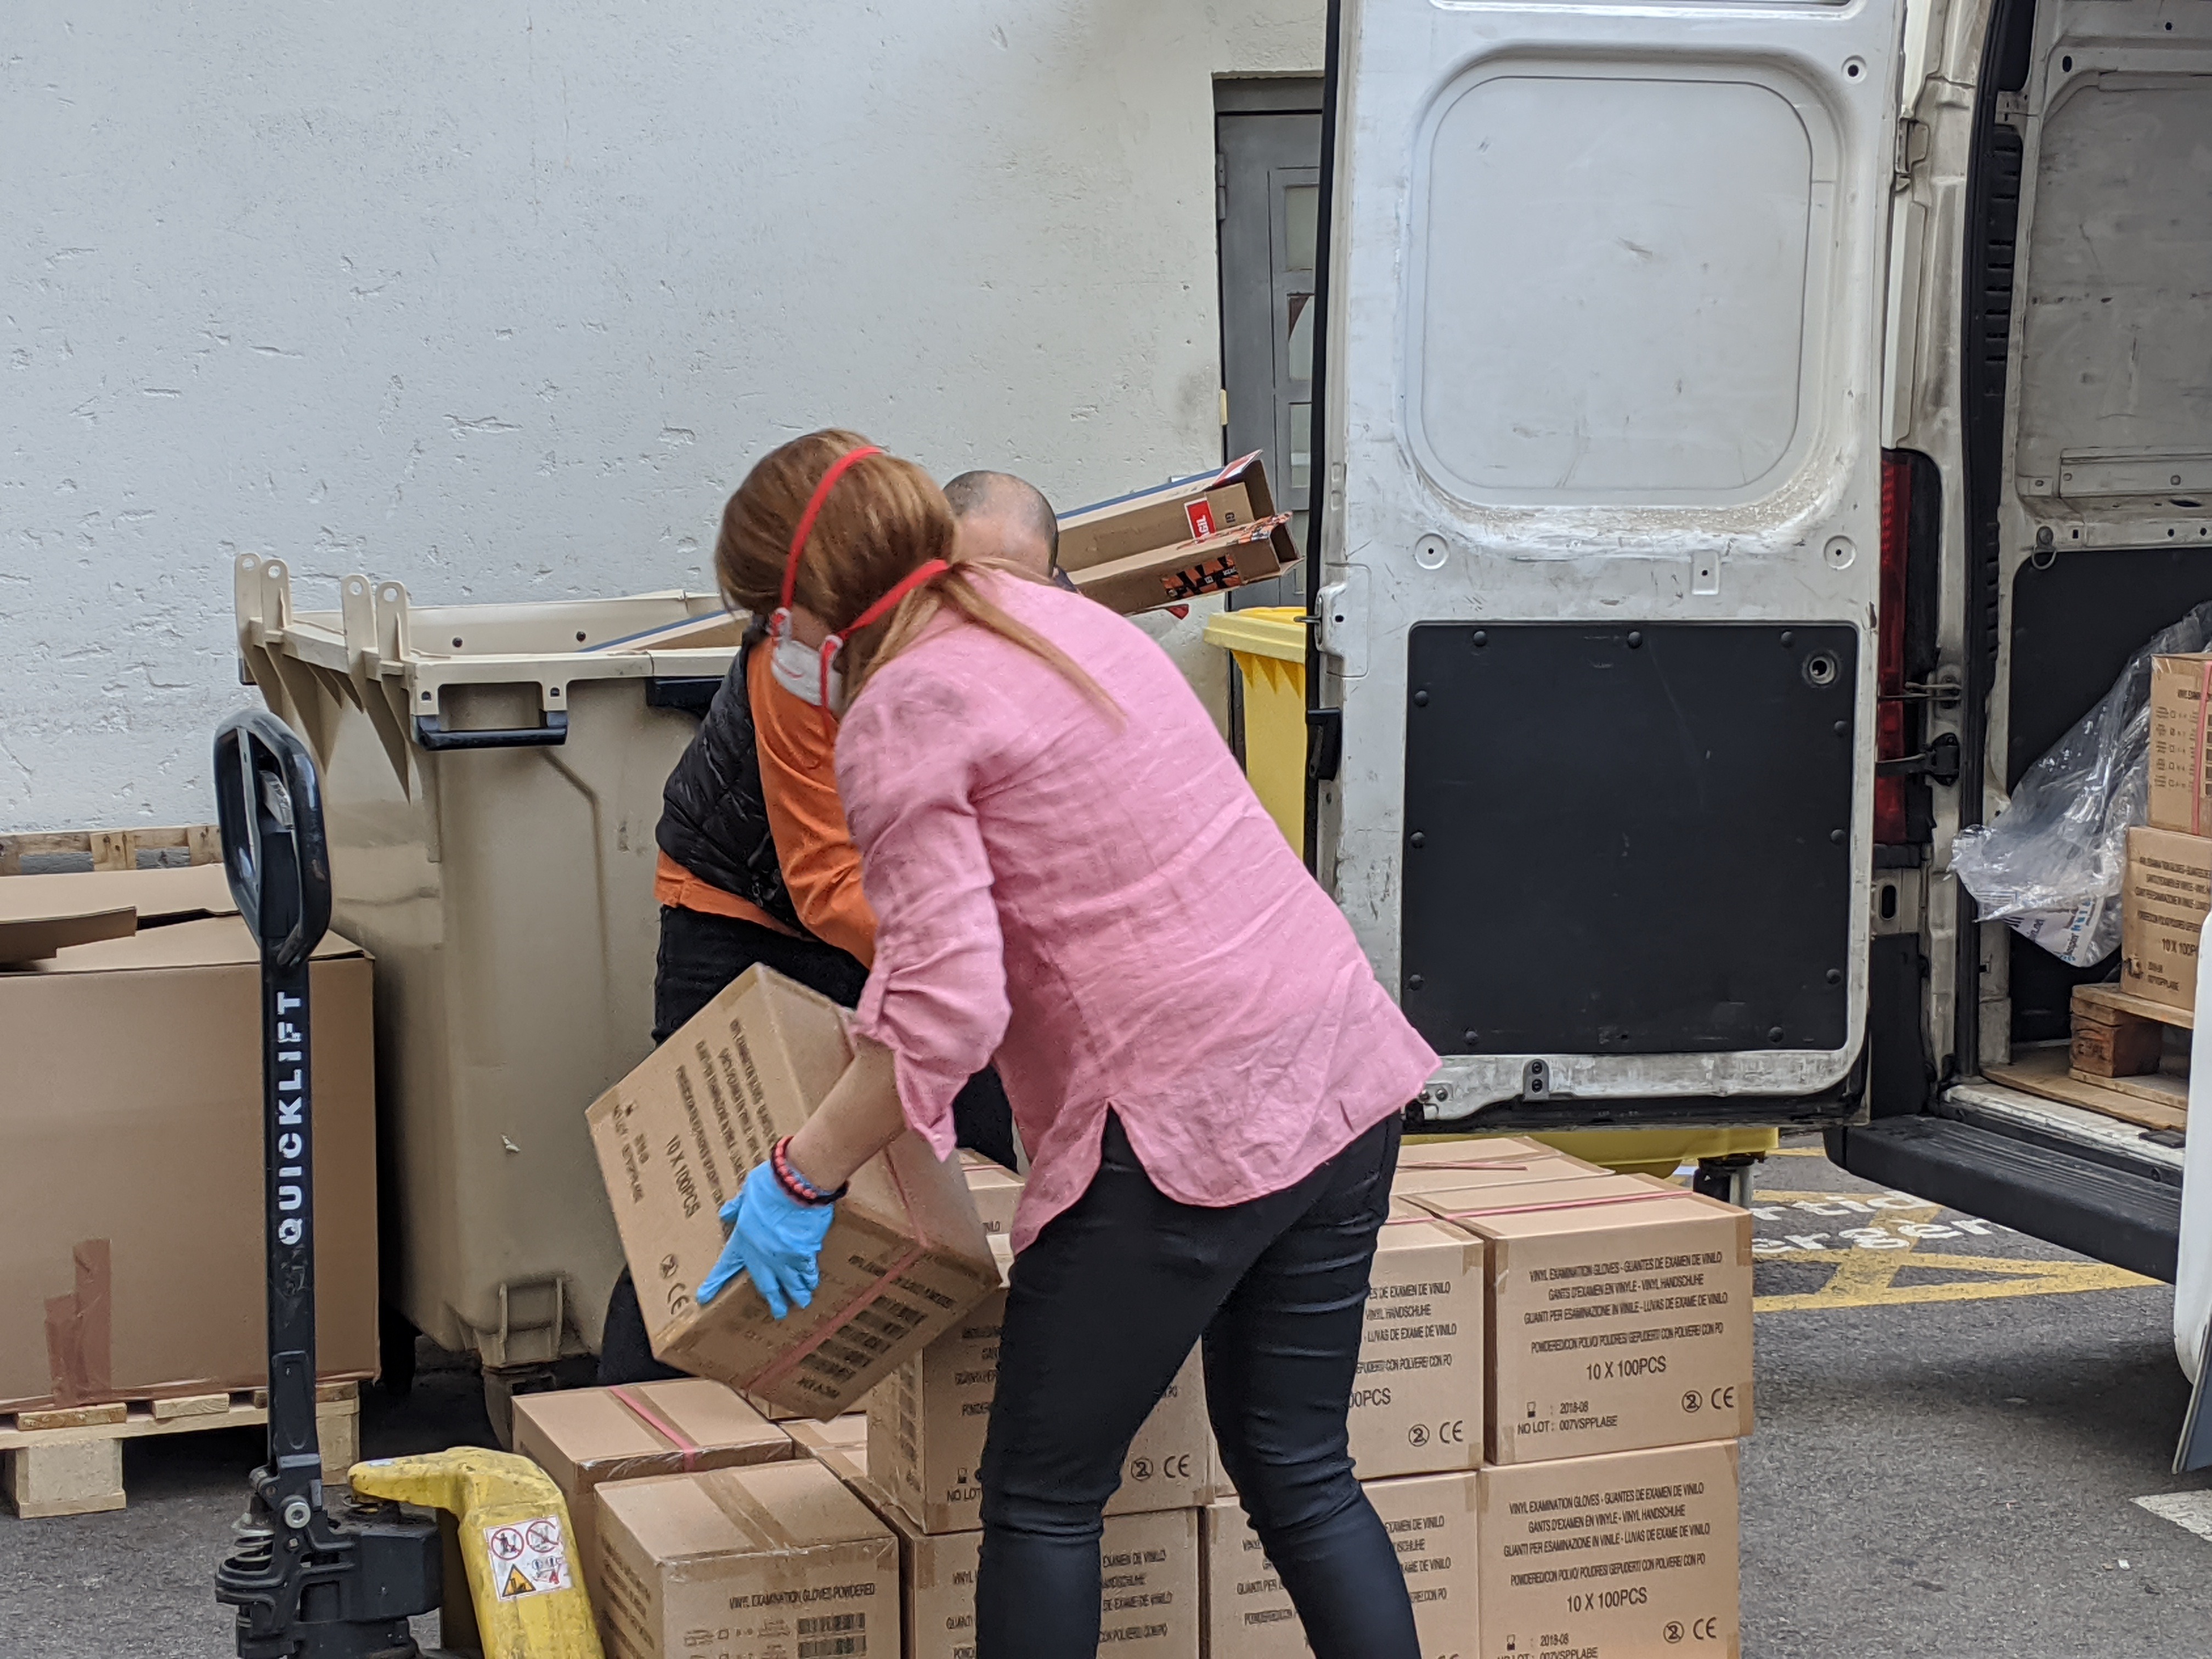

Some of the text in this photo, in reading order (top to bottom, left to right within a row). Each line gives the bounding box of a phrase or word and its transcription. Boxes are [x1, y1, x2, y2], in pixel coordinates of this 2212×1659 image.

[277, 991, 302, 1245] QUICKLIFT
[666, 1134, 701, 1219] 10 X 100PCS
[1655, 1256, 1664, 1269] DE
[1665, 1254, 1691, 1268] EXAMEN
[1692, 1254, 1701, 1265] DE
[1665, 1297, 1674, 1310] DE
[1698, 1294, 1707, 1306] DE
[1587, 1355, 1667, 1380] 10 X 100PCS
[1348, 1387, 1391, 1408] 00PCS
[1711, 1386, 1734, 1410] CE
[1439, 1420, 1463, 1444] CE
[1517, 1422, 1531, 1435] NO
[1164, 1454, 1190, 1479] CE
[1509, 1501, 1528, 1514] VINYL
[1574, 1493, 1599, 1508] GLOVES
[1605, 1489, 1634, 1504] GUANTES
[1635, 1488, 1645, 1501] DE
[1646, 1486, 1672, 1499] EXAMEN
[1673, 1485, 1682, 1497] DE
[1683, 1482, 1704, 1496] VINILO
[1528, 1520, 1550, 1533] GANTS
[1585, 1515, 1594, 1527] EN
[1622, 1509, 1641, 1522] VINYL
[1504, 1543, 1528, 1557] GUANTI
[1530, 1542, 1543, 1555] PER
[1624, 1530, 1645, 1543] LUVAS
[1646, 1528, 1655, 1541] DE
[1656, 1526, 1678, 1540] EXAME
[1679, 1525, 1689, 1537] DE
[1689, 1522, 1711, 1536] VINILO
[1642, 1559, 1654, 1572] CON
[1684, 1554, 1696, 1566] CON
[1696, 1553, 1706, 1564] PO
[1567, 1587, 1647, 1612] 10 X 100PCS
[1692, 1617, 1717, 1640] CE
